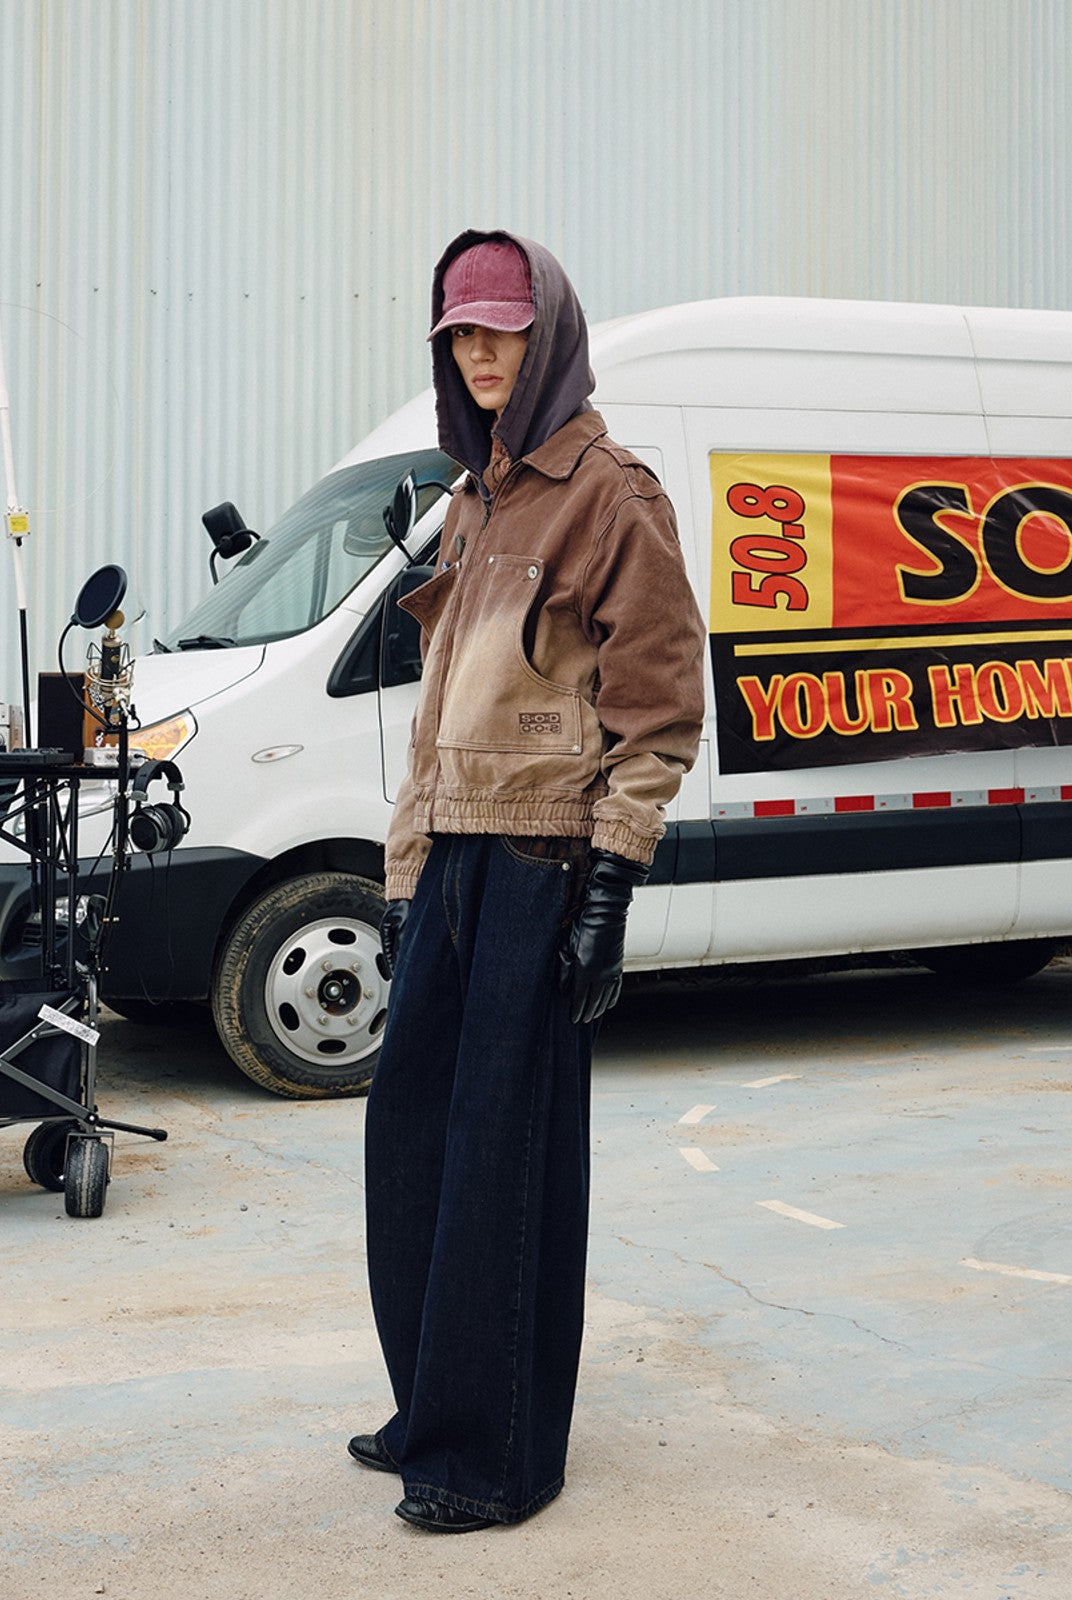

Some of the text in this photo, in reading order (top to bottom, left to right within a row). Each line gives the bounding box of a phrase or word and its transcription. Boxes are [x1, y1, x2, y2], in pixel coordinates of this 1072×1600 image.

[726, 482, 809, 612] 50.8
[736, 658, 1072, 742] YOUR HOM
